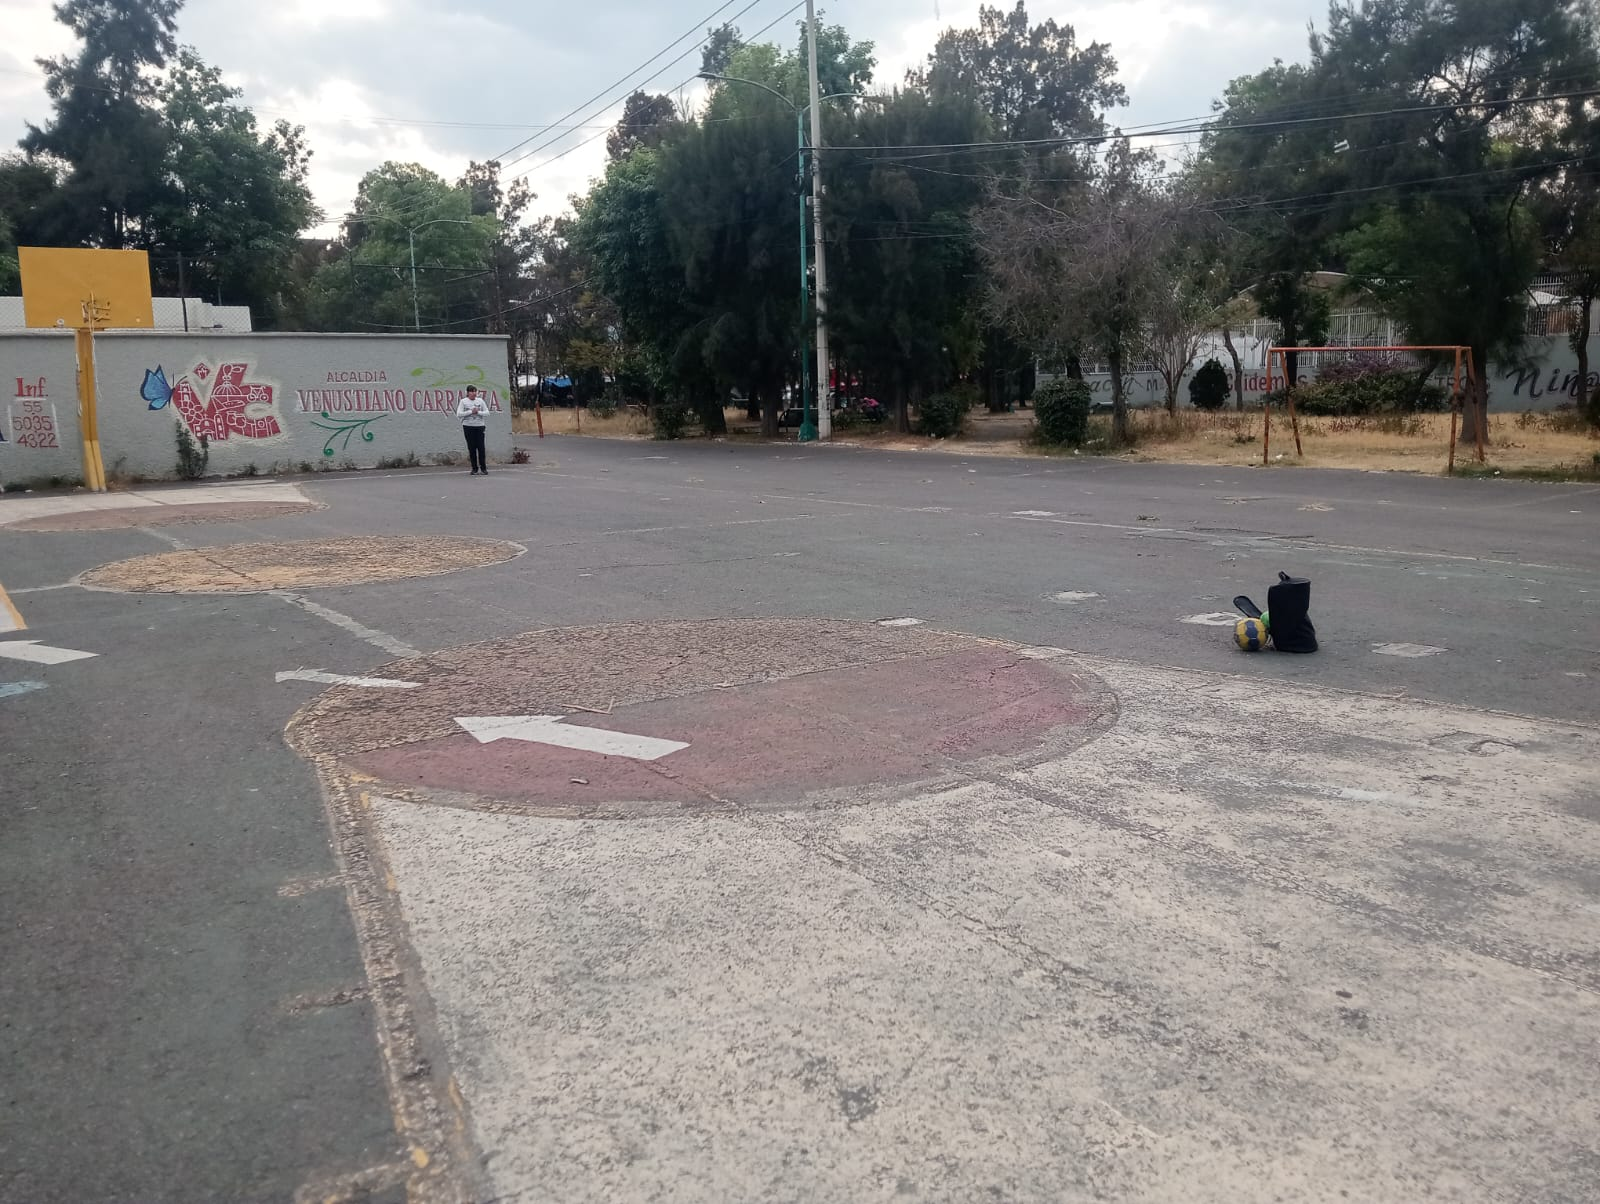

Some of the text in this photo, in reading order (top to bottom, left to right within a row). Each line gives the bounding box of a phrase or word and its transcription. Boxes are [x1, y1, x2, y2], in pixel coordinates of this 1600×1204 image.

[327, 371, 387, 382] ALCALDIA
[23, 400, 43, 413] 55
[296, 388, 406, 413] VENUSTIANO
[13, 415, 53, 431] 5035
[17, 432, 59, 449] 4322
